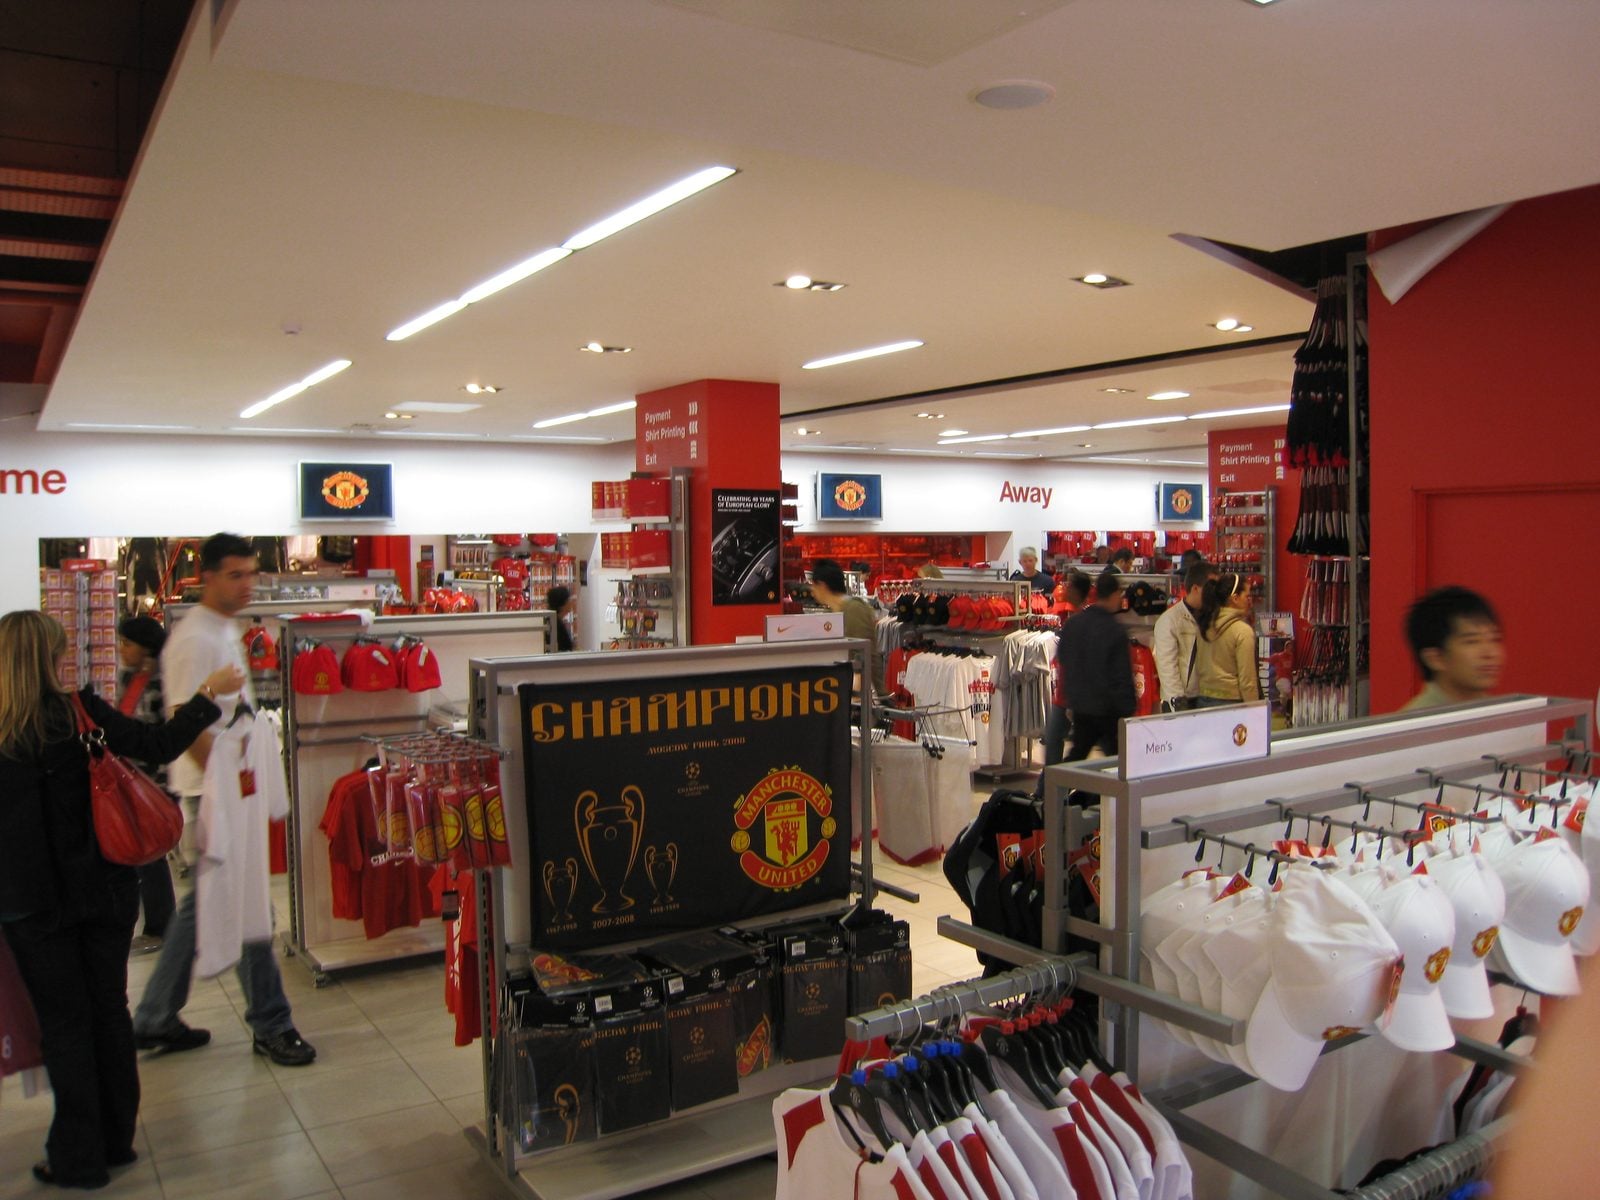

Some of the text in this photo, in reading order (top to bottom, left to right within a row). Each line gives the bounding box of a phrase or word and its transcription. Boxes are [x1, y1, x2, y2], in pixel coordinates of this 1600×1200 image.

[644, 410, 671, 425] Payment
[645, 426, 686, 442] Shirt Printing
[1220, 443, 1253, 454] Payment
[645, 453, 657, 466] Exit
[1220, 454, 1270, 466] Shirt Printing
[1220, 474, 1235, 483] Exit
[999, 480, 1053, 510] Away
[530, 676, 840, 743] CHAMPIONS
[1145, 740, 1173, 755] Men's
[742, 775, 828, 822] MANCHESTER
[758, 858, 818, 884] UNITED
[592, 914, 636, 929] 2007-2008
